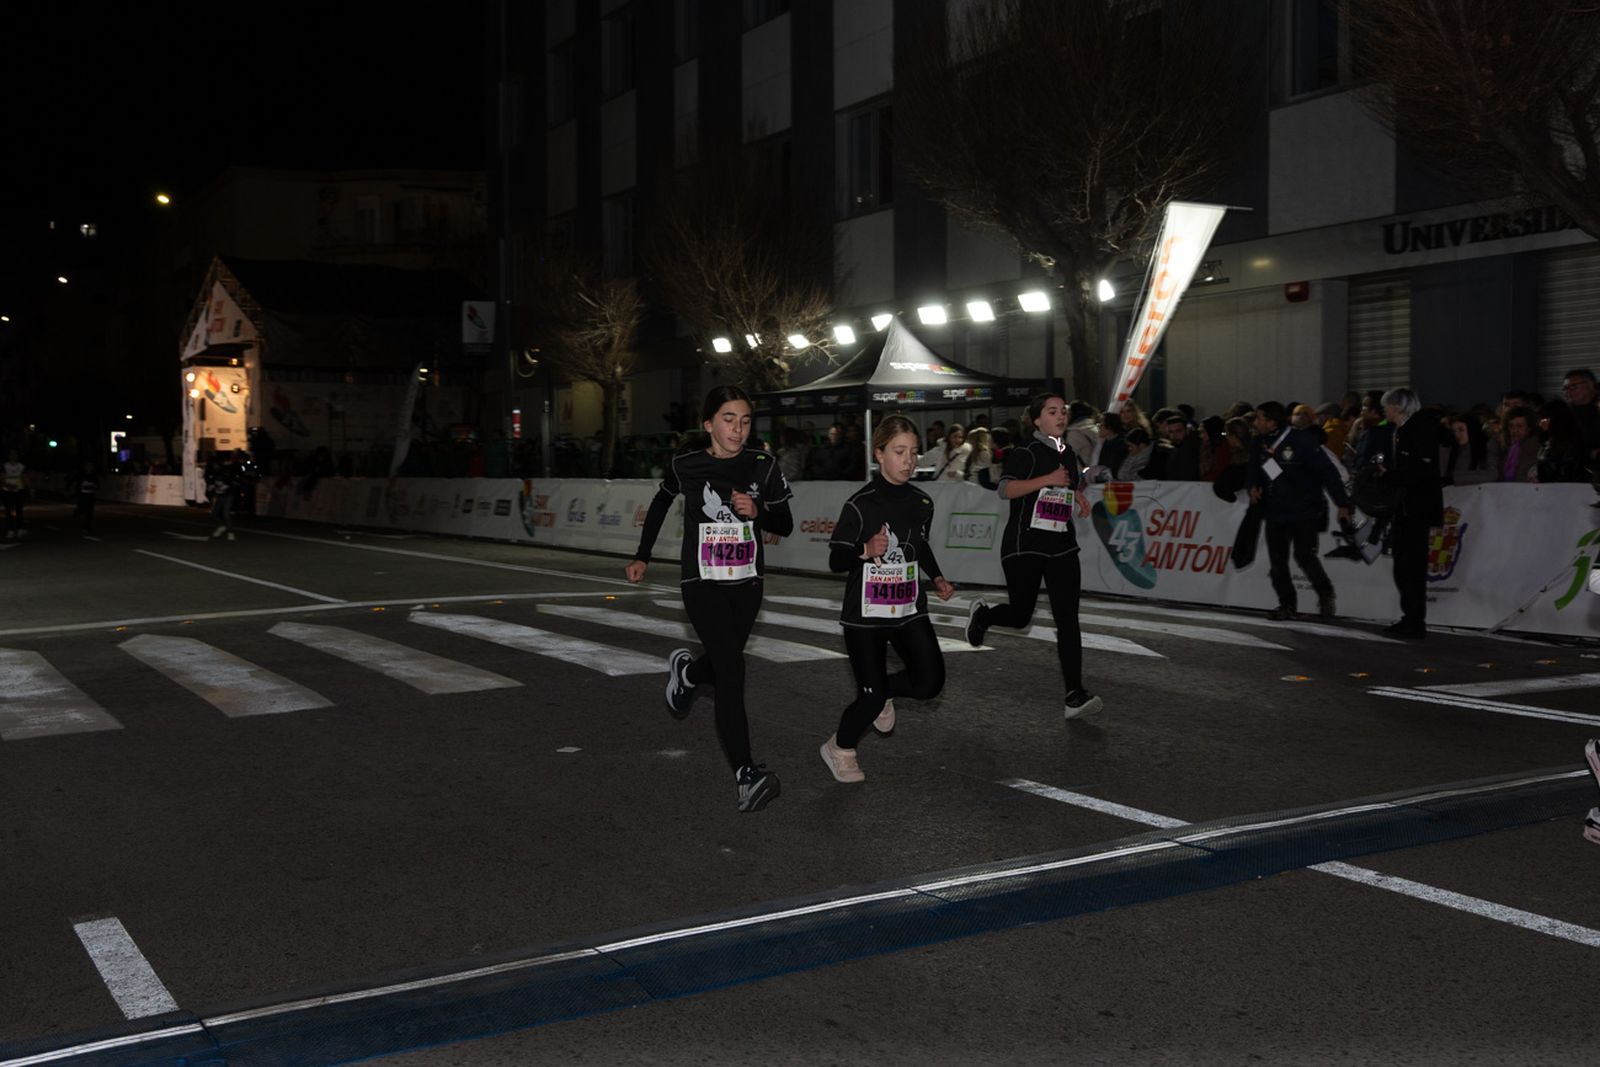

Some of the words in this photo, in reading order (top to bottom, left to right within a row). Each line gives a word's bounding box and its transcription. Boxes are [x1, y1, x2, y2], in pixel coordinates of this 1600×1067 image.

[716, 510, 733, 523] 43
[1146, 508, 1201, 538] SAN
[707, 543, 751, 561] 14261
[1107, 519, 1142, 563] 43
[1140, 535, 1233, 575] ANTÓN
[872, 582, 913, 599] 14166
